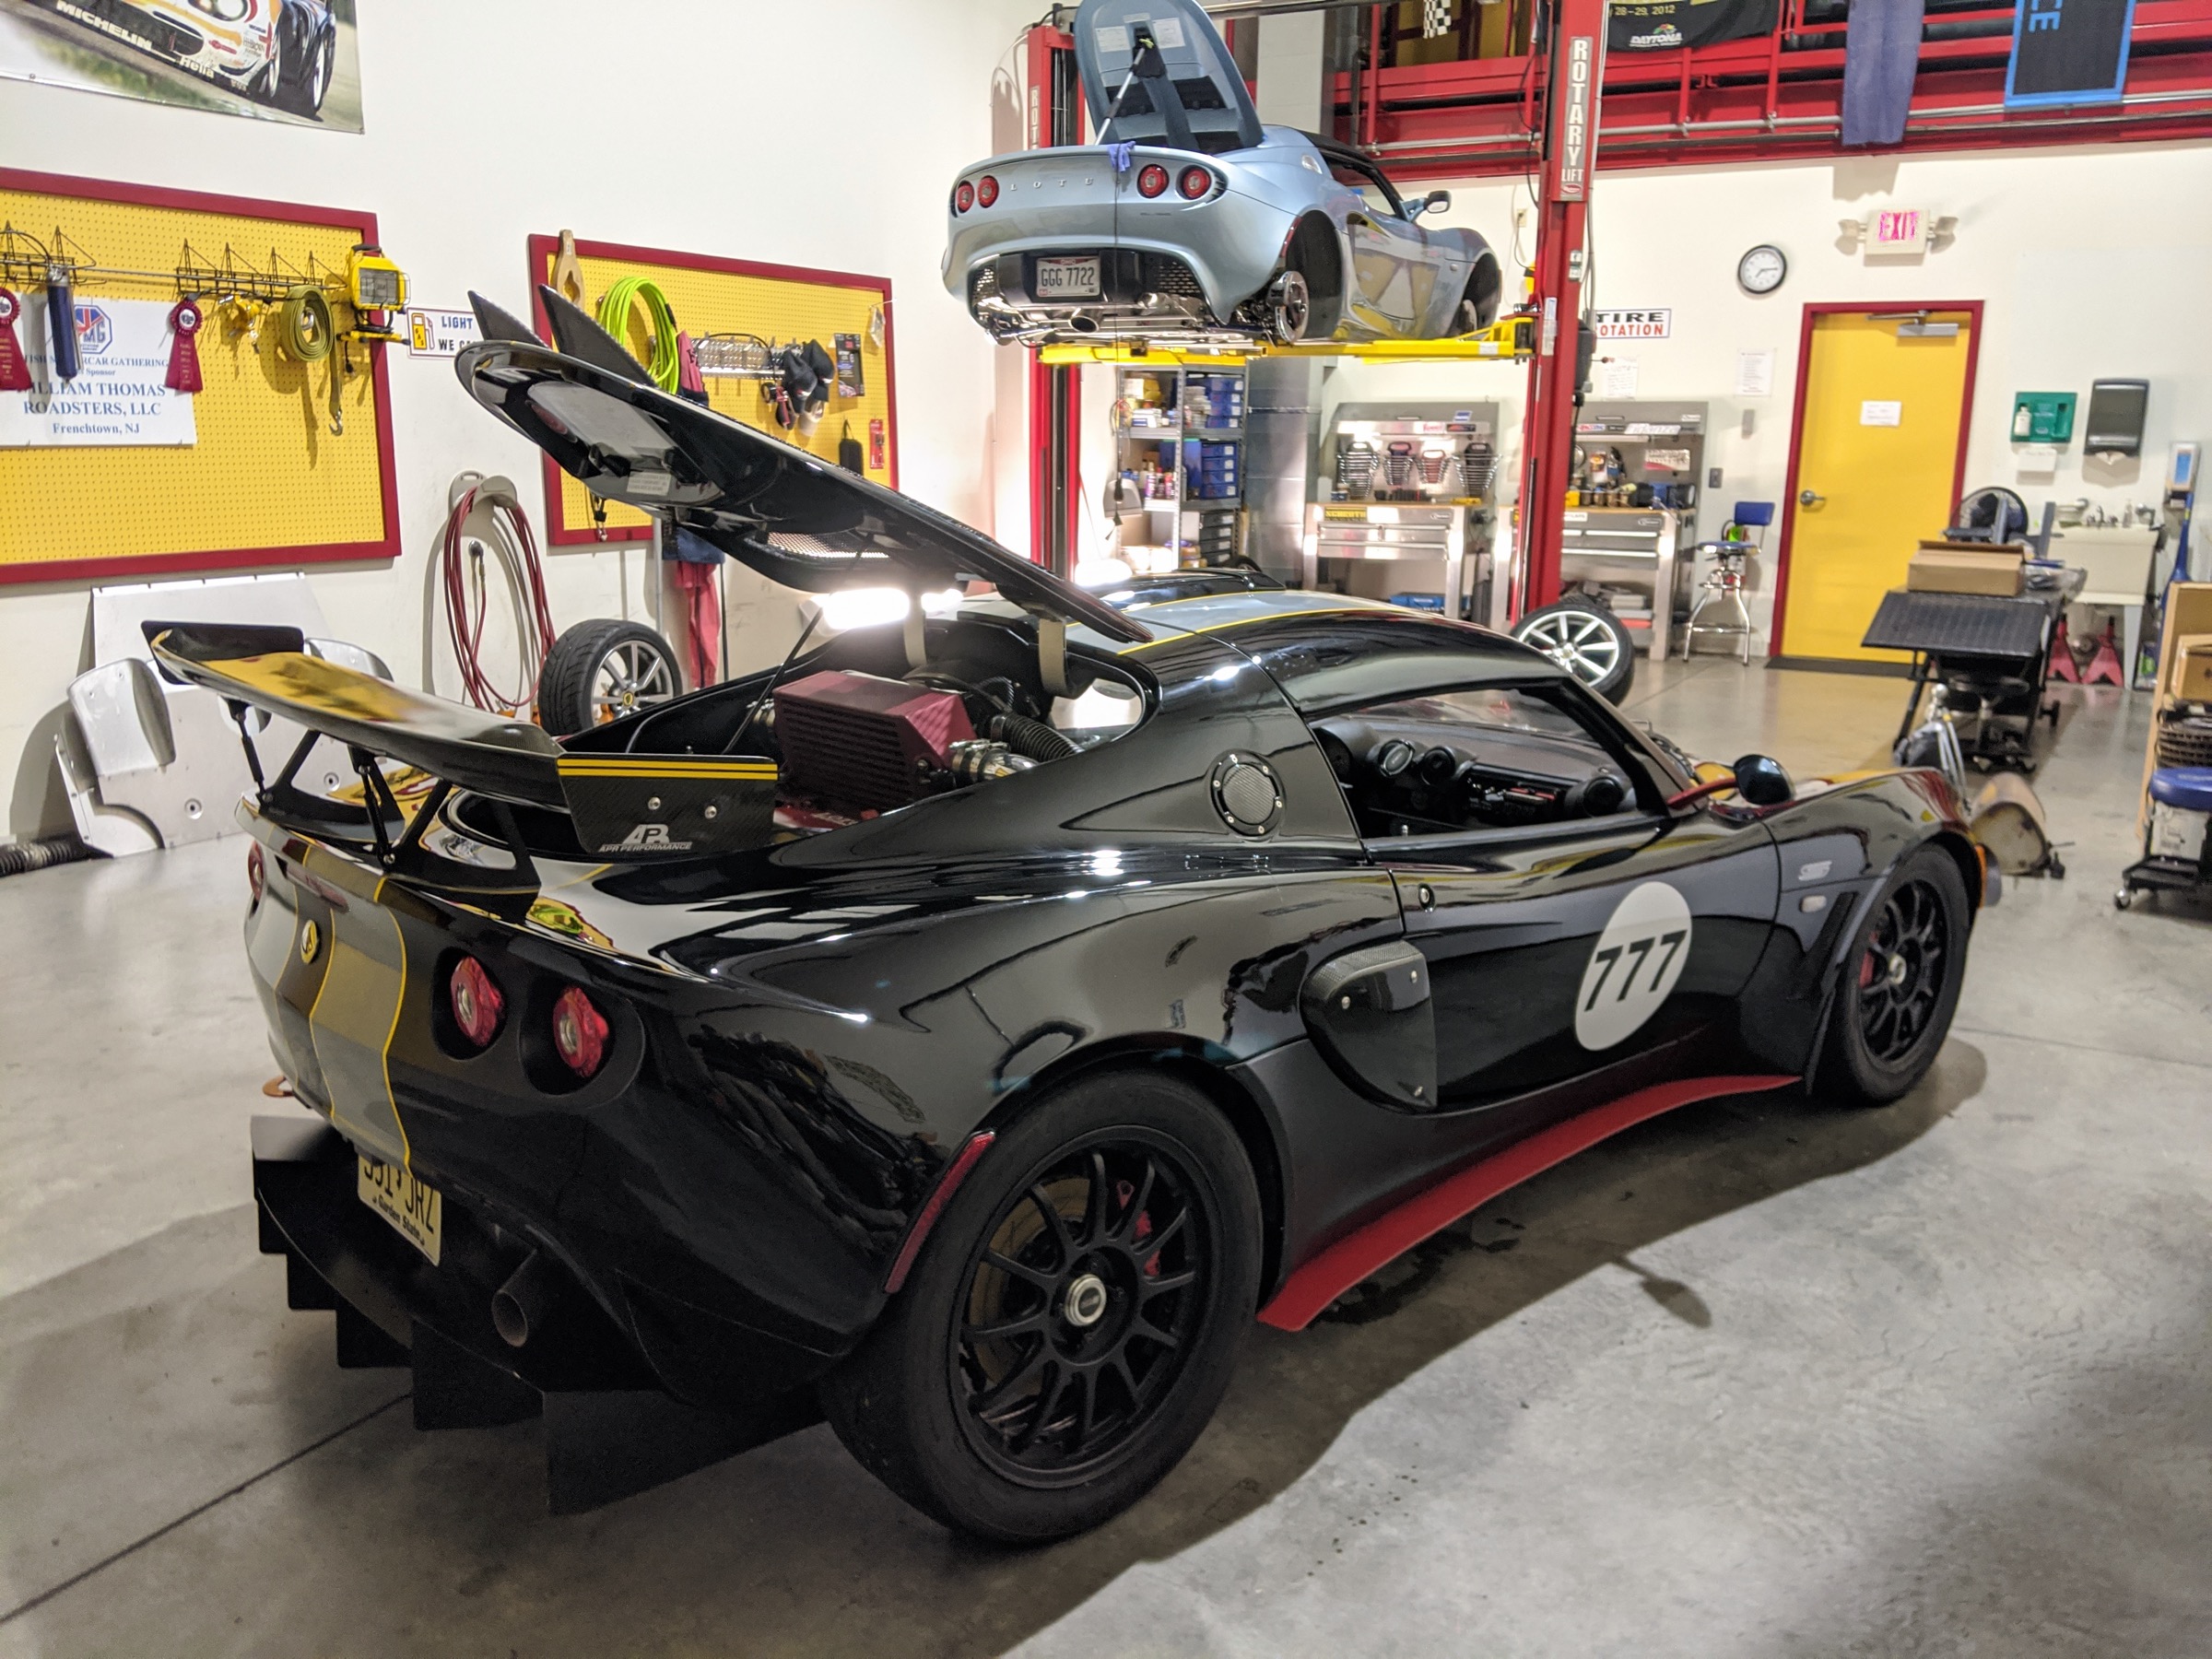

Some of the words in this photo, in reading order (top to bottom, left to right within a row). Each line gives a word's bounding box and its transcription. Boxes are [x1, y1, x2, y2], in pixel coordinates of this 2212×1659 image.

[1652, 5, 1676, 15] 2012
[56, 0, 152, 51] MICHELIN
[1630, 33, 1683, 44] DAYTONA
[179, 55, 214, 79] Hella
[1568, 40, 1587, 167] ROTARY
[1561, 169, 1584, 182] LIFT
[1010, 177, 1121, 192] LOTU
[1879, 211, 1919, 241] EXIT
[1041, 267, 1062, 287] GGG
[1066, 266, 1095, 286] 7722
[441, 316, 474, 329] LIGHT
[1596, 312, 1664, 323] TIRE
[1598, 324, 1664, 336] OTATION
[439, 338, 454, 350] WE
[112, 358, 169, 368] GATHERING
[86, 369, 116, 378] Sponsor
[29, 382, 92, 395] ILLIAM
[96, 383, 166, 396] THOMAS
[24, 401, 126, 417] ROADSTERS,
[131, 402, 161, 416] LLC
[53, 423, 123, 435] Frenchtown,
[125, 424, 140, 434] NJ
[598, 843, 619, 853] APR
[620, 841, 693, 852] PERFORMANCE
[1584, 929, 1688, 1012] 777
